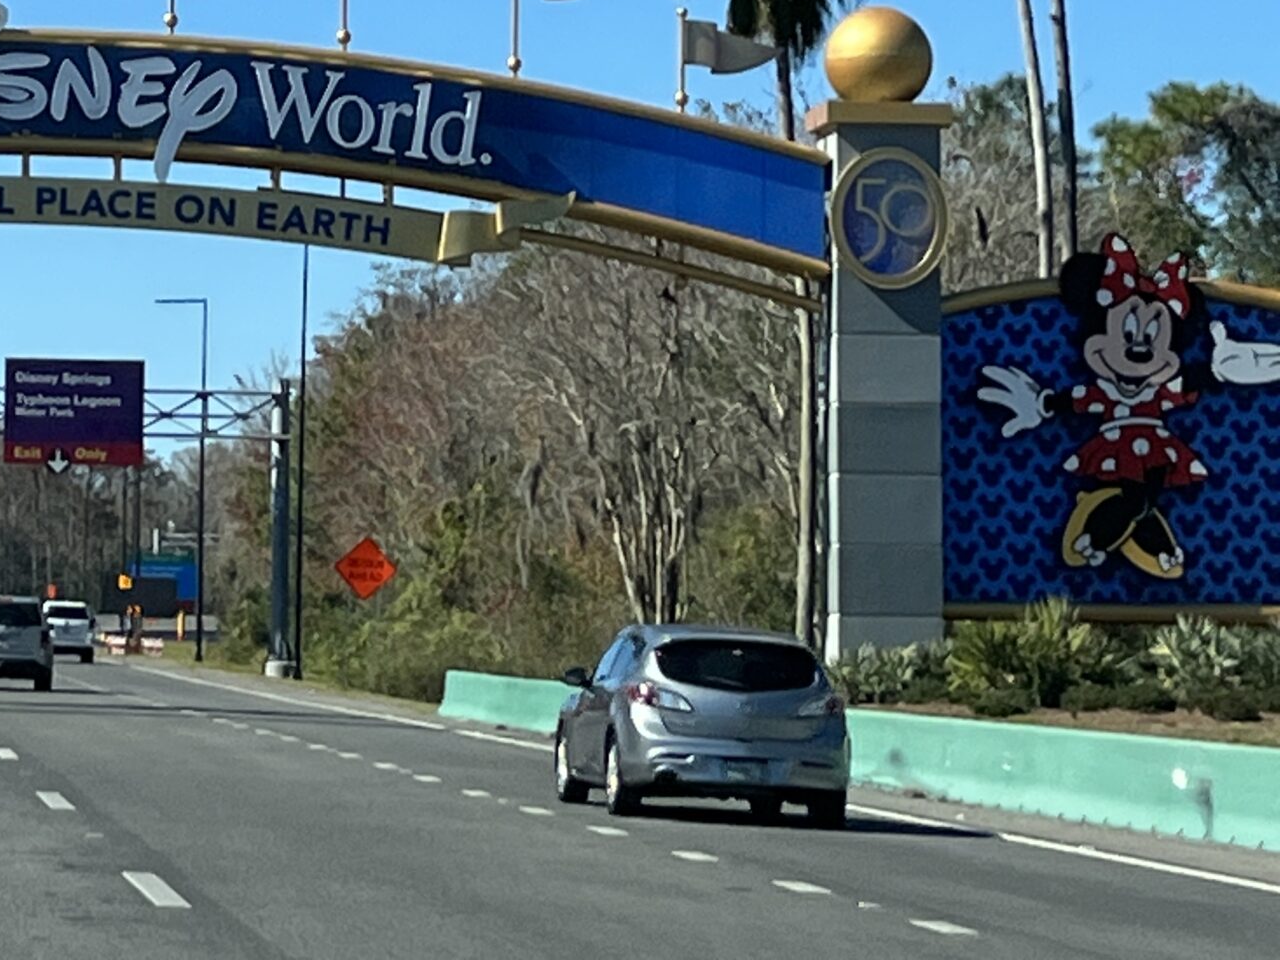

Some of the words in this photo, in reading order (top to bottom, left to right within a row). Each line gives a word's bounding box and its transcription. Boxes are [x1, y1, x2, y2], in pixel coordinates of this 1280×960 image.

[36, 187, 157, 219] PLACE
[175, 194, 236, 227] ON
[257, 202, 391, 246] EARTH
[856, 178, 934, 262] 50
[15, 371, 59, 386] Disney
[62, 372, 111, 386] Springs
[73, 394, 121, 408] Lagoon
[14, 446, 42, 459] Exit
[74, 447, 107, 462] Only
